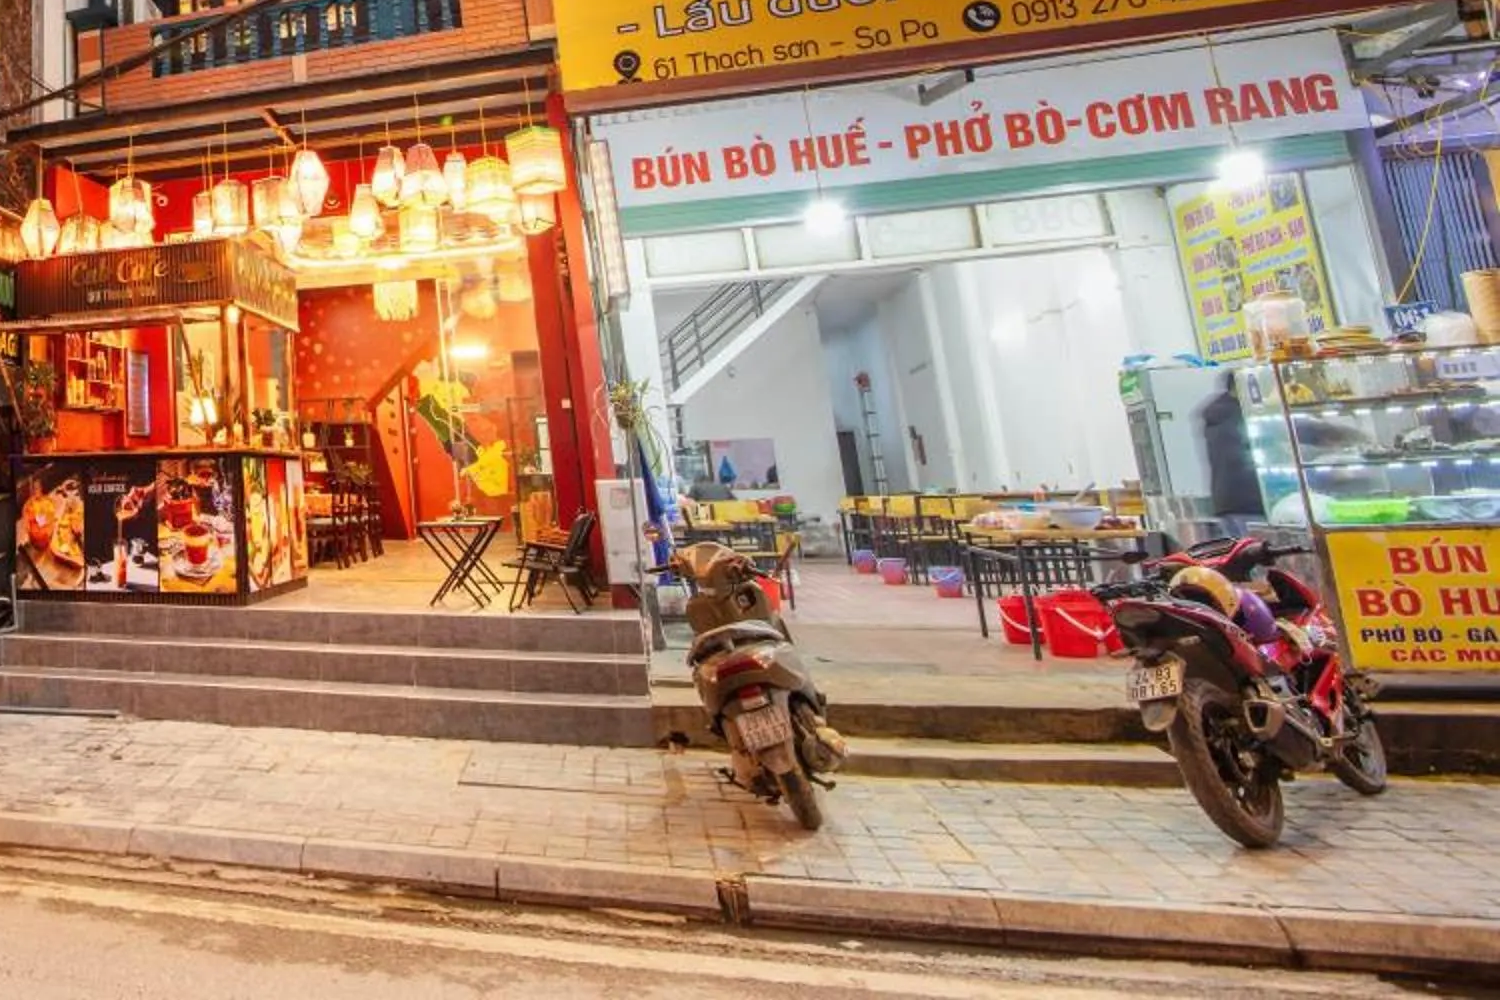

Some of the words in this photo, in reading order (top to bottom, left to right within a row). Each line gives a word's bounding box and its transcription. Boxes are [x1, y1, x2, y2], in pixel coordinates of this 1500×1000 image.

[653, 56, 678, 80] 61
[855, 25, 891, 50] Sa
[901, 18, 940, 42] Pa
[631, 146, 711, 190] BÚN
[722, 134, 777, 180] BÒ
[789, 117, 872, 173] HUẾ
[904, 101, 994, 160] PHỞ
[1203, 73, 1340, 126] RANG
[1387, 536, 1489, 575] BÚN
[1355, 580, 1423, 618] BÒ
